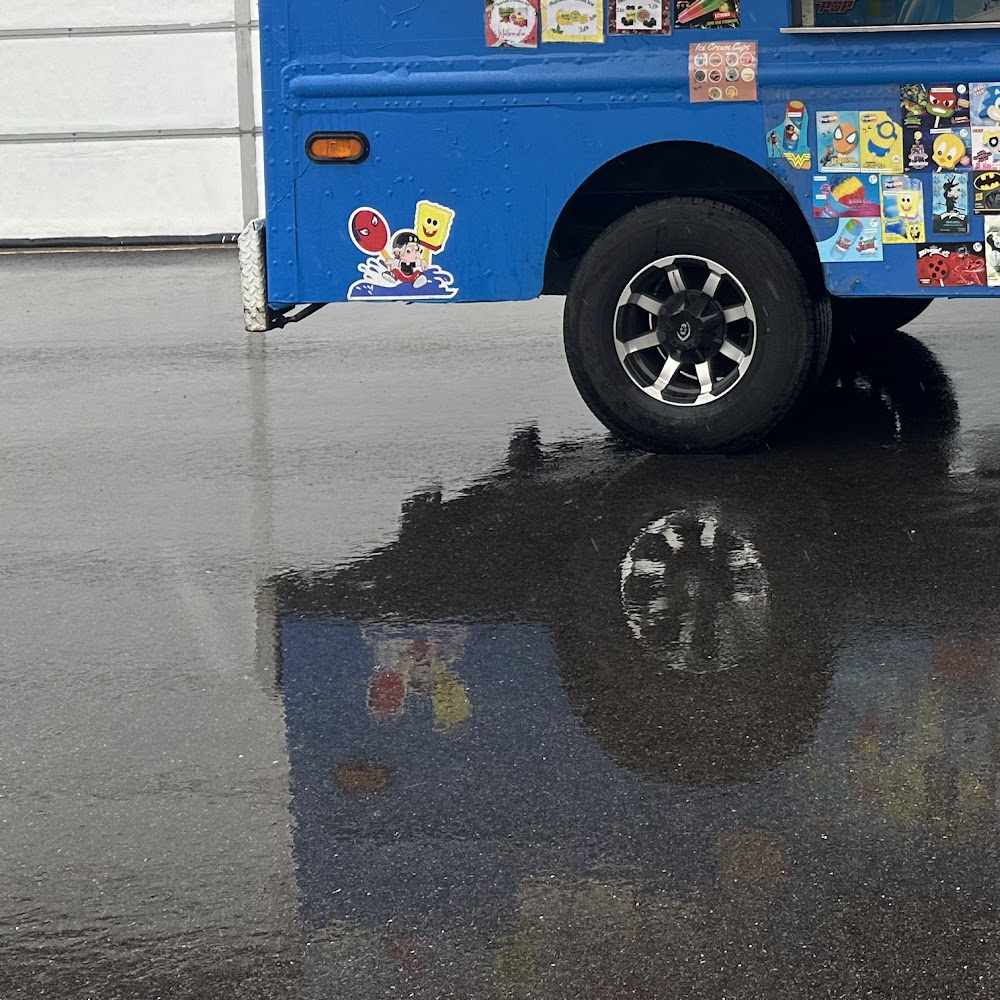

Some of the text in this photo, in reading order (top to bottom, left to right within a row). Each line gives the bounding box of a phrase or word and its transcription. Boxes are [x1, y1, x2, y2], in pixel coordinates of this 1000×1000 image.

[818, 0, 856, 14] POP
[695, 42, 751, 53] Ice Cream Cups
